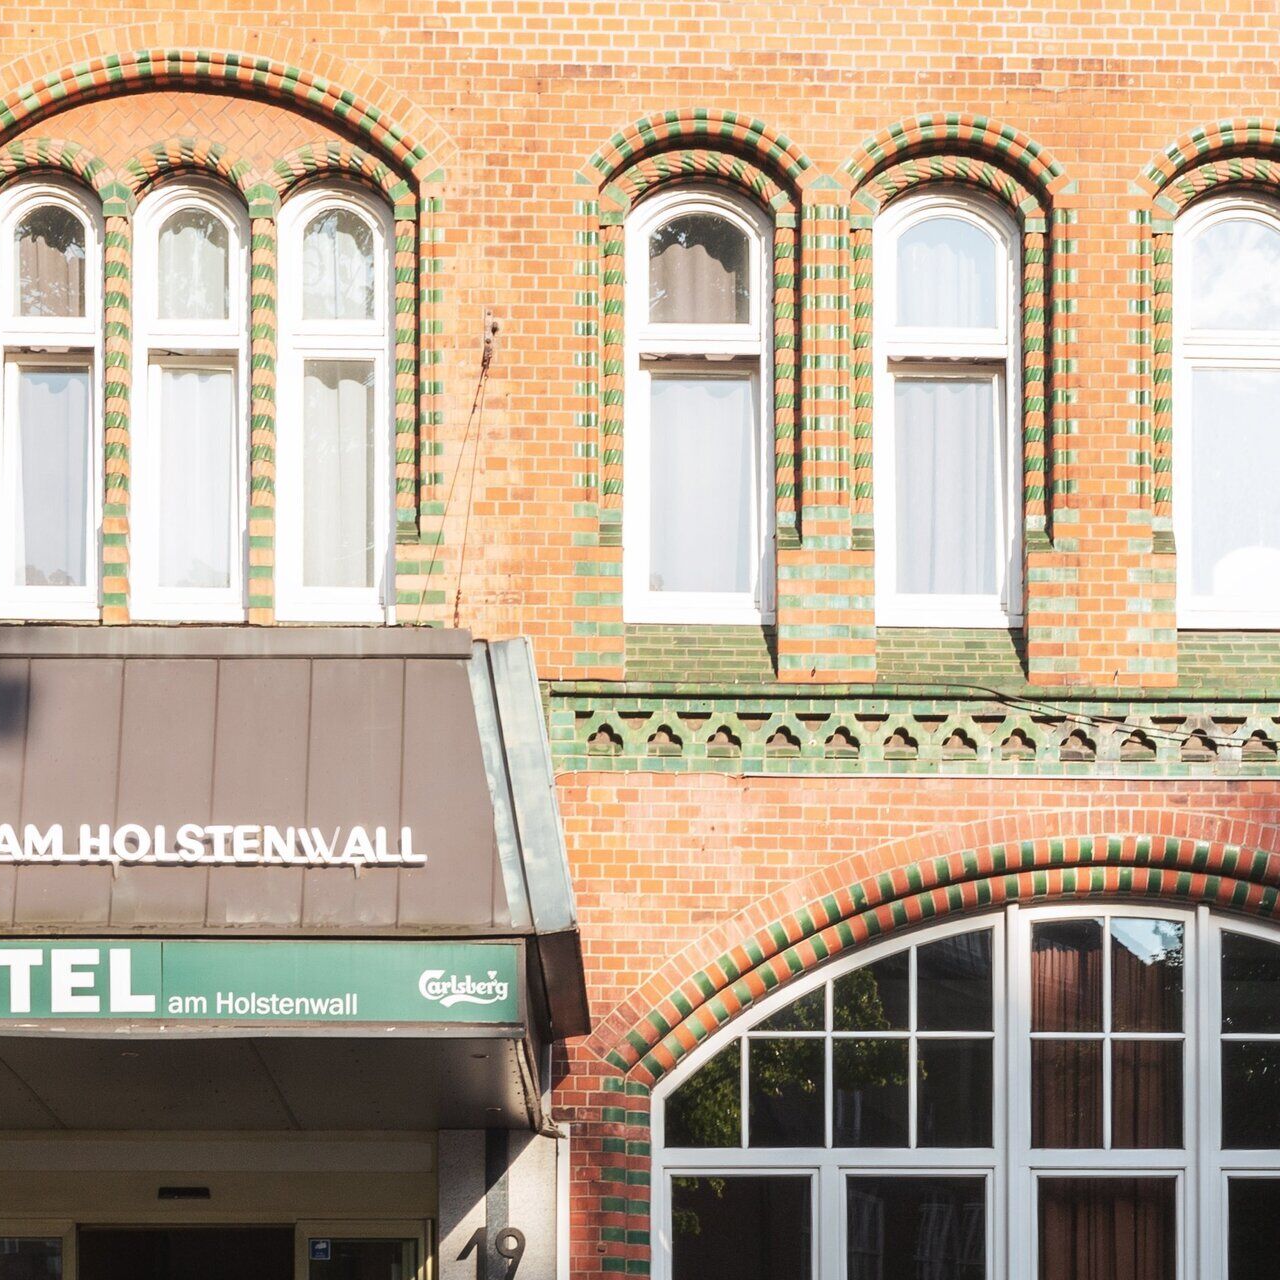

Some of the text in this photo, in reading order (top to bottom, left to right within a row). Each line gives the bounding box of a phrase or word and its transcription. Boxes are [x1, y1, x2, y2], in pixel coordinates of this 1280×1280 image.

[80, 823, 427, 864] HOLSTENWALL
[168, 994, 207, 1014] am
[216, 991, 358, 1015] Holstenwall
[419, 969, 509, 1003] Carlsberg
